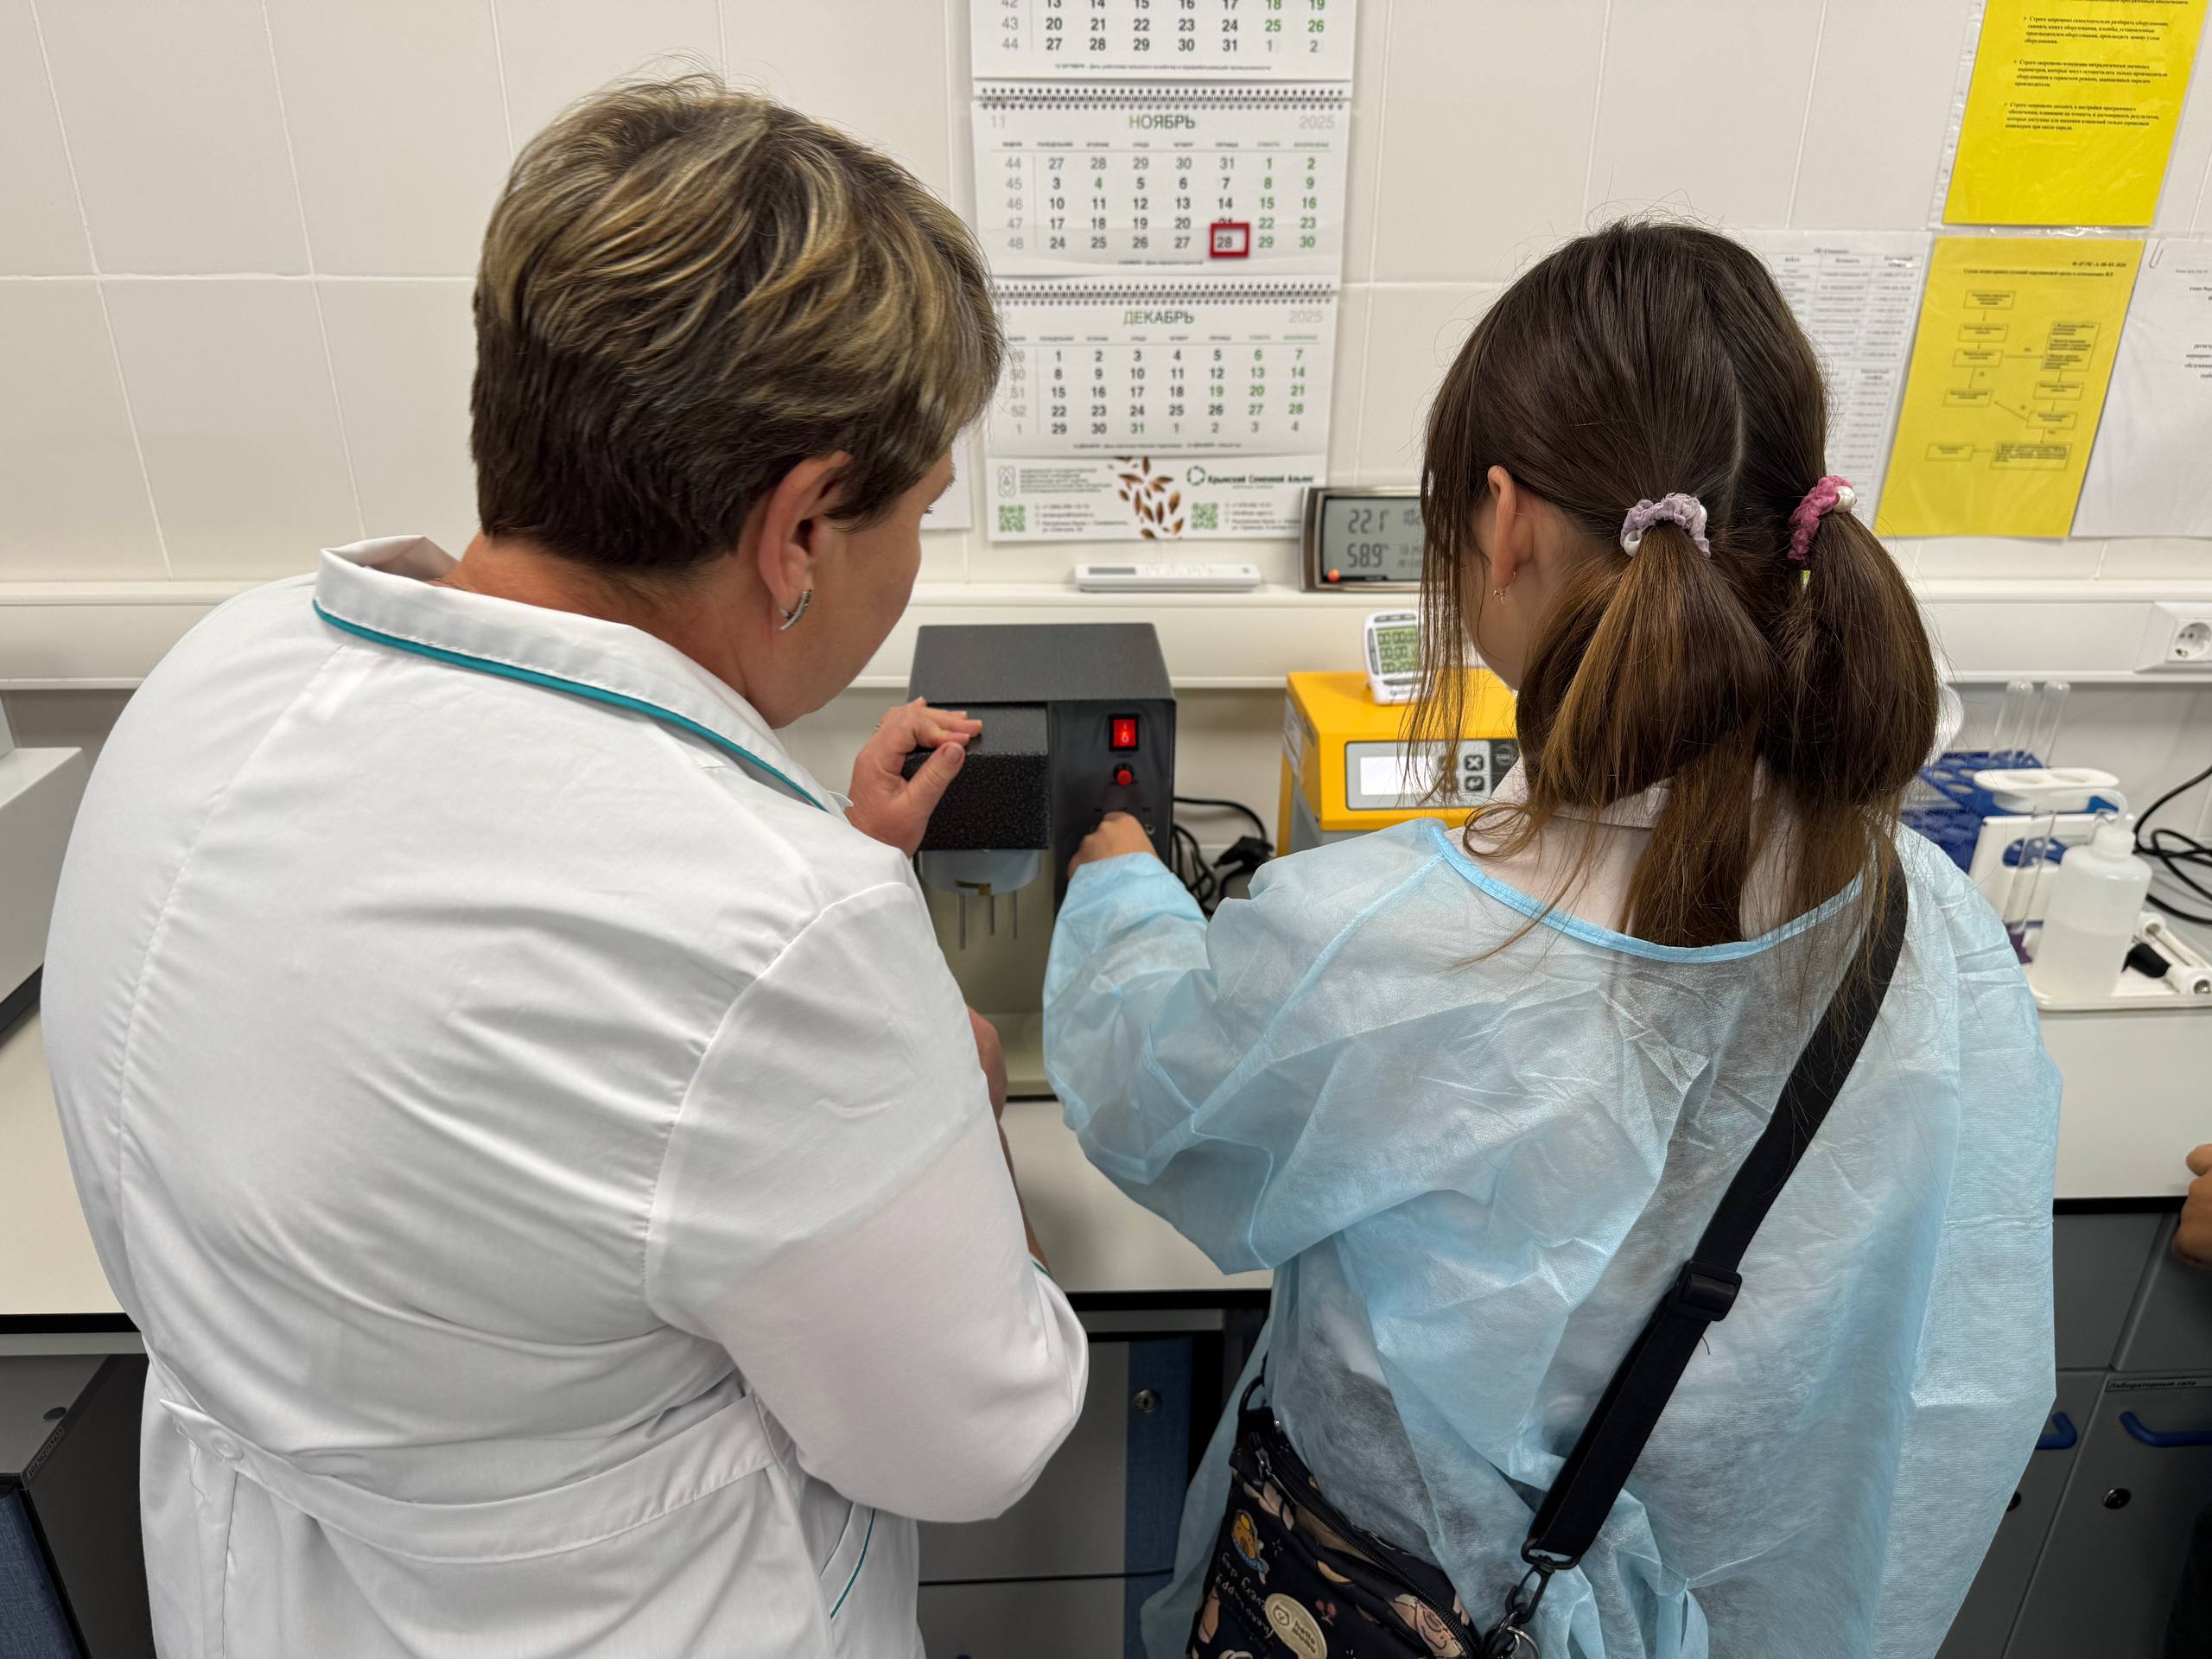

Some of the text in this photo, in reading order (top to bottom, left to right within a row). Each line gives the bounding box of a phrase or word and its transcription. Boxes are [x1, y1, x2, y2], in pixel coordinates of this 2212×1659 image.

[1046, 16, 1063, 31] 20
[1090, 17, 1106, 32] 21
[1133, 17, 1150, 32] 22
[1178, 17, 1196, 32] 23
[1222, 18, 1238, 33] 24
[1264, 18, 1282, 33] 25
[1307, 18, 1325, 33] 26
[1046, 37, 1063, 51] 27
[1090, 36, 1107, 52] 28
[1133, 37, 1150, 52] 29
[1178, 37, 1196, 52] 30
[1222, 38, 1238, 53] 31
[1128, 114, 1196, 130] НОЯБРЬ
[1299, 115, 1336, 130] 2025
[1048, 156, 1065, 171] 27
[1090, 156, 1108, 170] 28
[1133, 156, 1150, 170] 29
[1175, 156, 1193, 170] 30
[1219, 156, 1235, 170] 31
[1049, 196, 1065, 211] 10
[1091, 197, 1106, 210] 11
[1133, 196, 1148, 211] 12
[1174, 196, 1191, 211] 13
[1218, 197, 1233, 209] 14
[1260, 196, 1275, 210] 15
[1301, 196, 1318, 210] 16
[1050, 217, 1065, 230] 17
[1091, 217, 1107, 230] 18
[1133, 217, 1148, 230] 19
[1174, 216, 1192, 230] 20
[1257, 216, 1275, 230] 22
[1300, 215, 1317, 230] 23
[1049, 236, 1066, 250] 24
[1090, 236, 1108, 250] 25
[1132, 236, 1149, 250] 26
[1173, 235, 1191, 250] 27
[1216, 236, 1232, 249] 28
[1257, 235, 1274, 249] 29
[1299, 235, 1316, 249] 30
[1123, 309, 1324, 326] ДЕКАБРЬ 2025
[1130, 367, 1146, 380] 10
[1171, 367, 1185, 379] 11
[1210, 367, 1225, 380] 12
[1250, 365, 1266, 379] 13
[1291, 365, 1306, 378] 14
[1052, 385, 1066, 399] 15
[1091, 385, 1107, 398] 16
[1130, 385, 1145, 397] 17
[1170, 385, 1185, 398] 18
[1209, 385, 1224, 397] 19
[1249, 384, 1266, 397] 20
[1290, 384, 1306, 397] 21
[1052, 404, 1067, 417] 22
[1090, 404, 1107, 417] 23
[1129, 404, 1145, 417] 24
[1168, 404, 1185, 417] 25
[1208, 404, 1224, 416] 26
[1248, 403, 1264, 416] 27
[1052, 422, 1068, 435] 29
[1091, 423, 1108, 435] 30
[1130, 422, 1145, 435] 31
